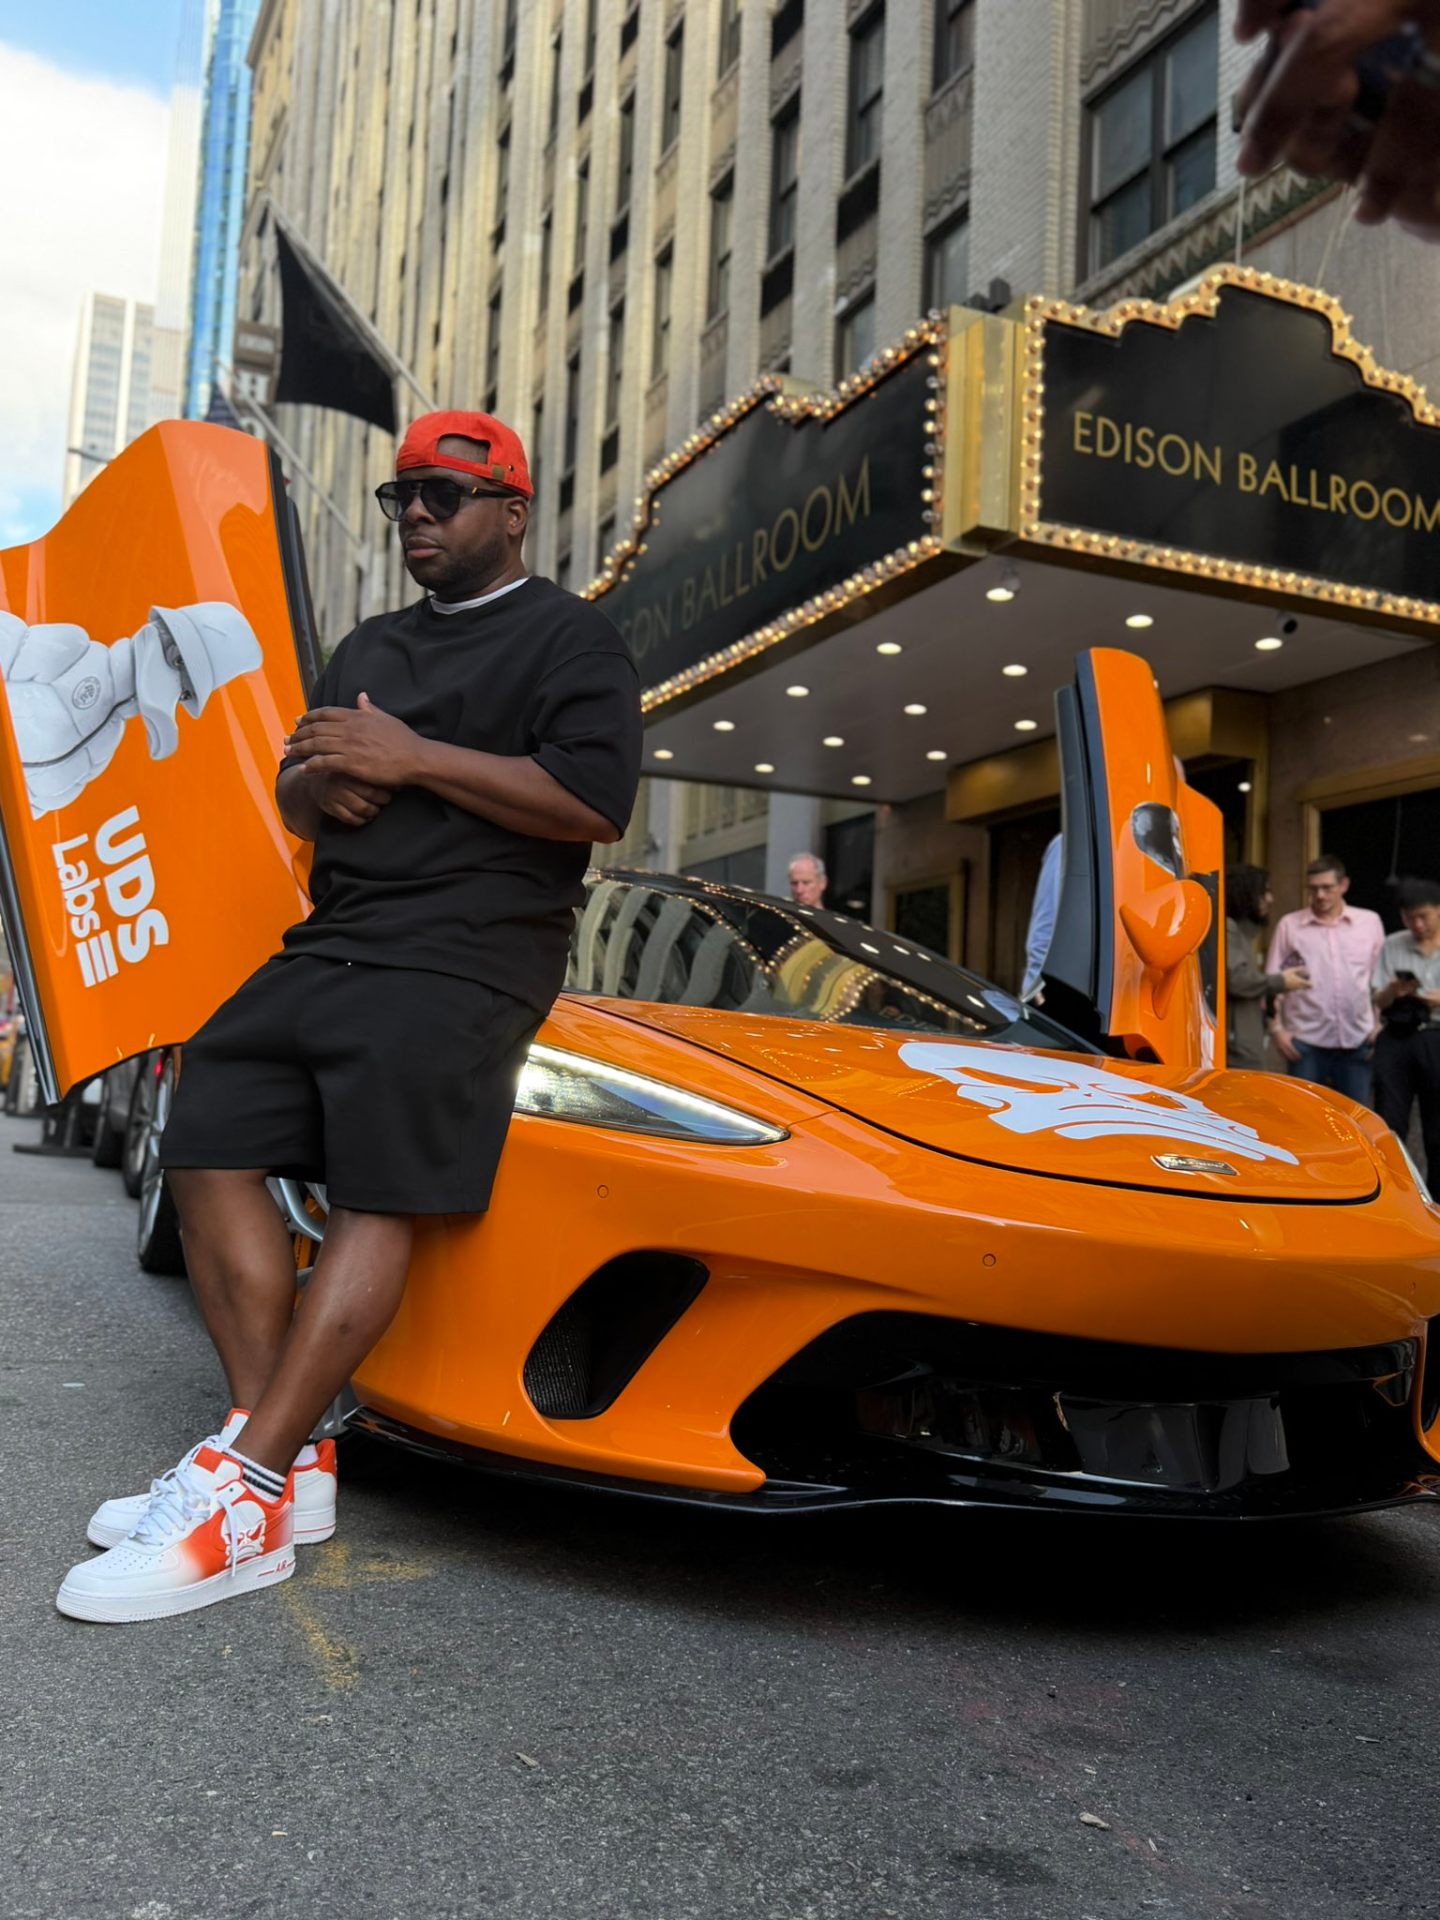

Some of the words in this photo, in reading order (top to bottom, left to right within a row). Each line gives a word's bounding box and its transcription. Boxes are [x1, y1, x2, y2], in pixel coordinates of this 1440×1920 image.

[682, 452, 871, 630] BALLROOM
[1073, 410, 1221, 485] EDISON
[1238, 452, 1440, 532] BALLROOM
[94, 804, 170, 963] UDS
